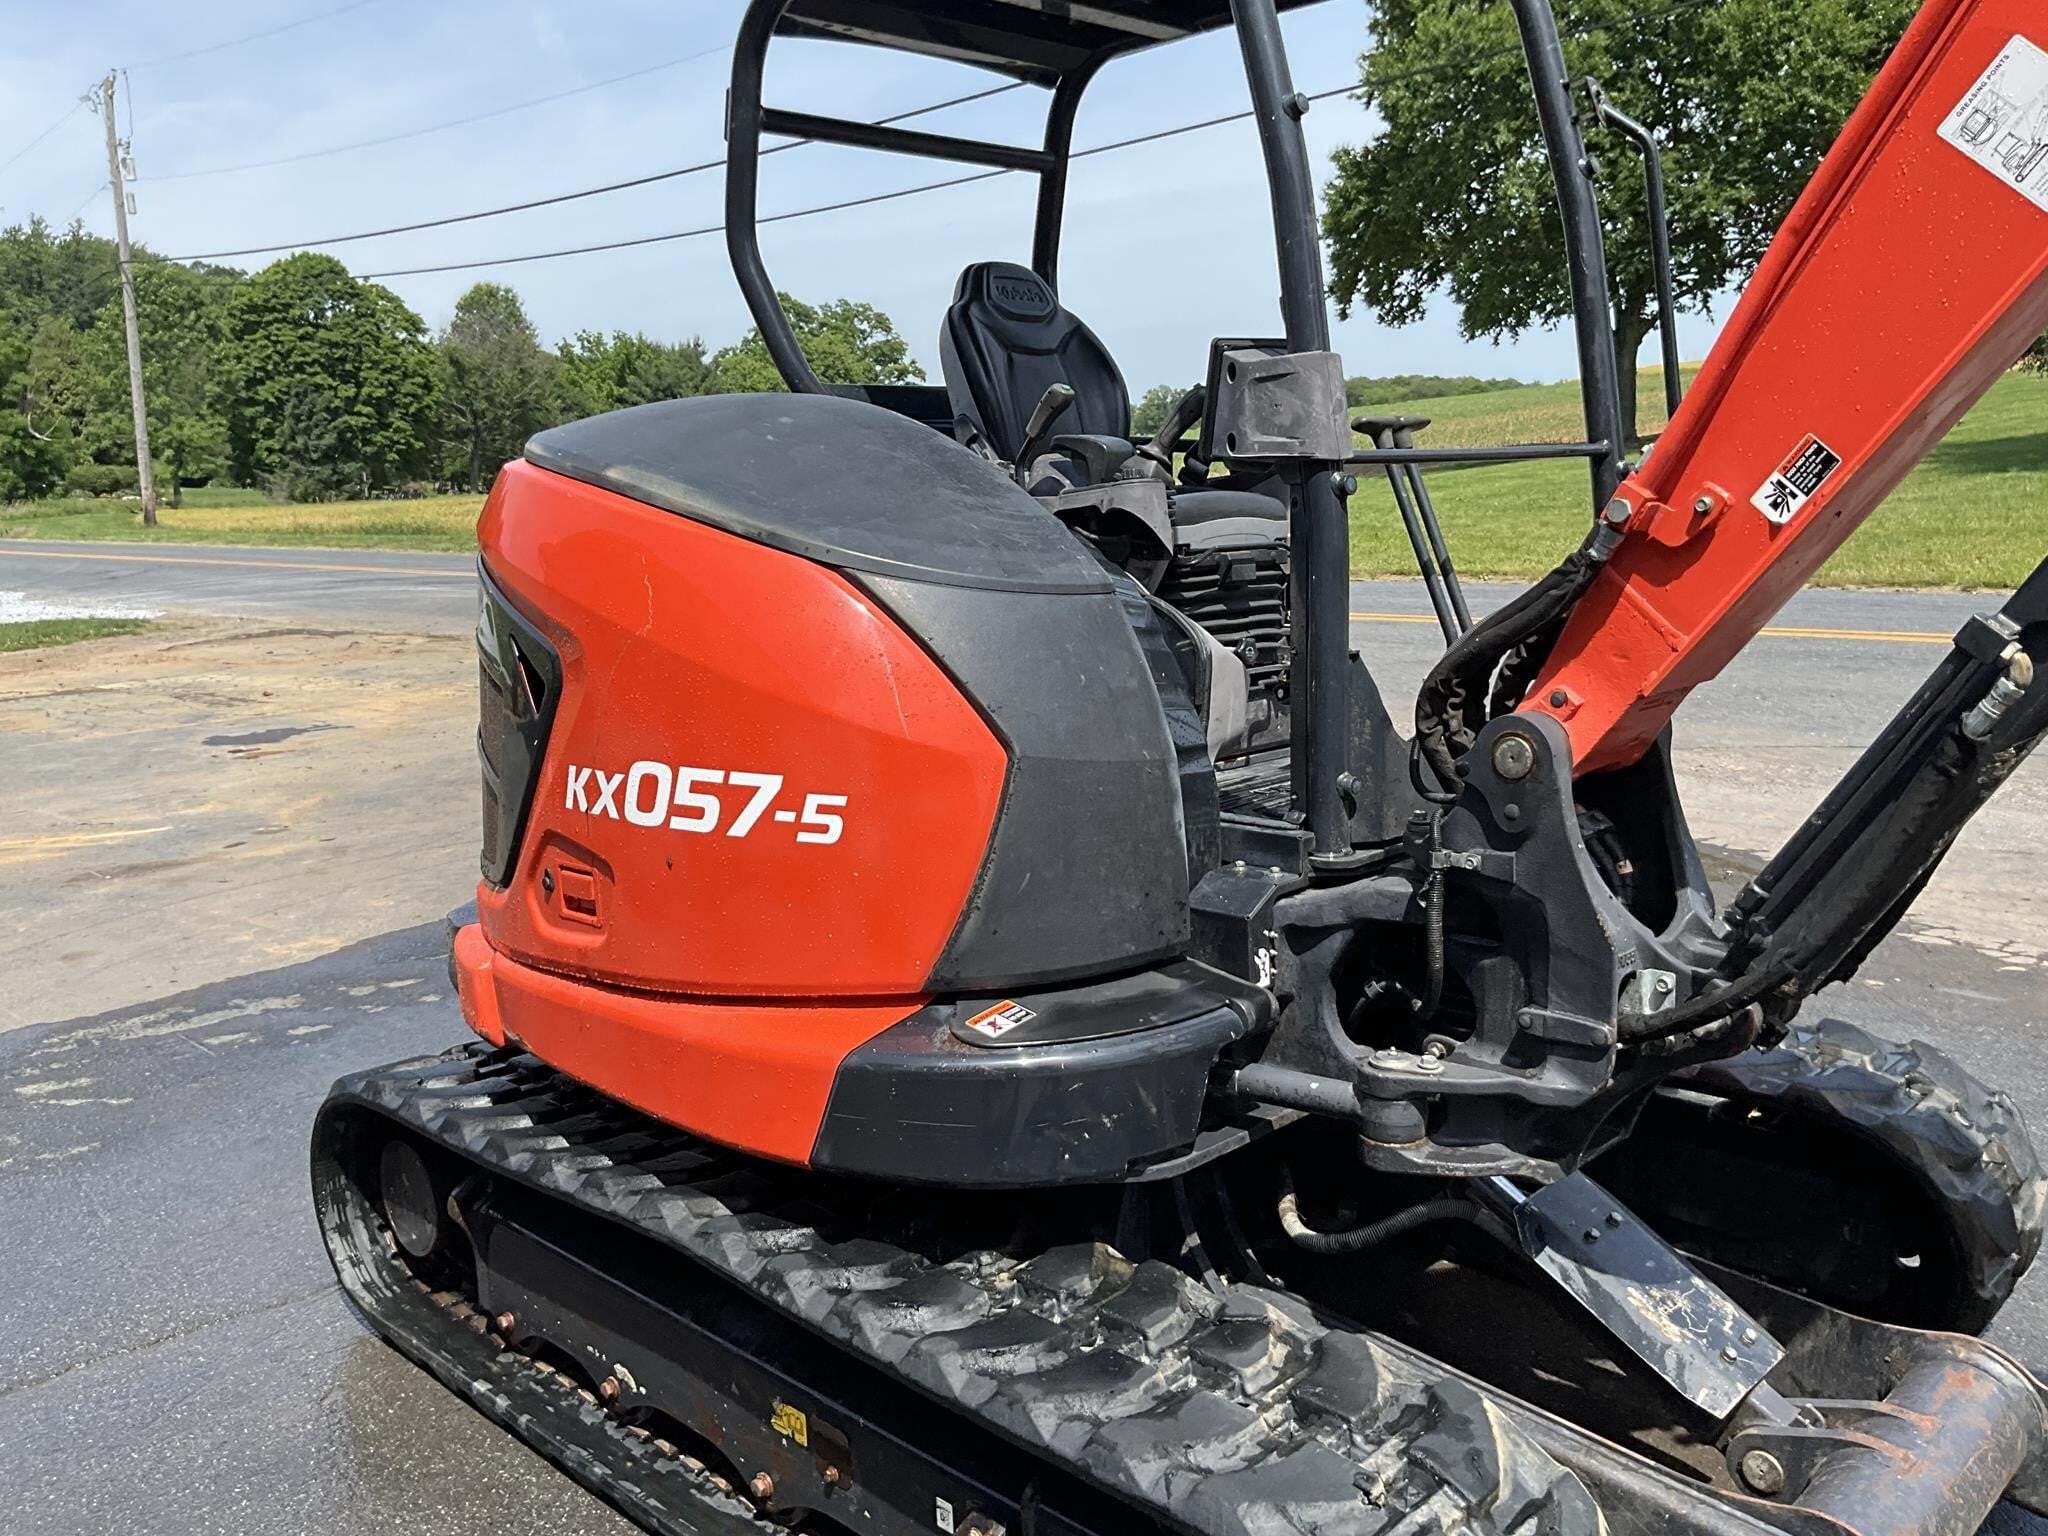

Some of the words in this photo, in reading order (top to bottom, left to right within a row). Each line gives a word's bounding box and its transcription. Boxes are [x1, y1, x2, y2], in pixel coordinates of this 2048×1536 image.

[1956, 81, 1988, 118] GREASING
[1986, 54, 2010, 81] POINTS
[565, 760, 848, 844] KX057-5
